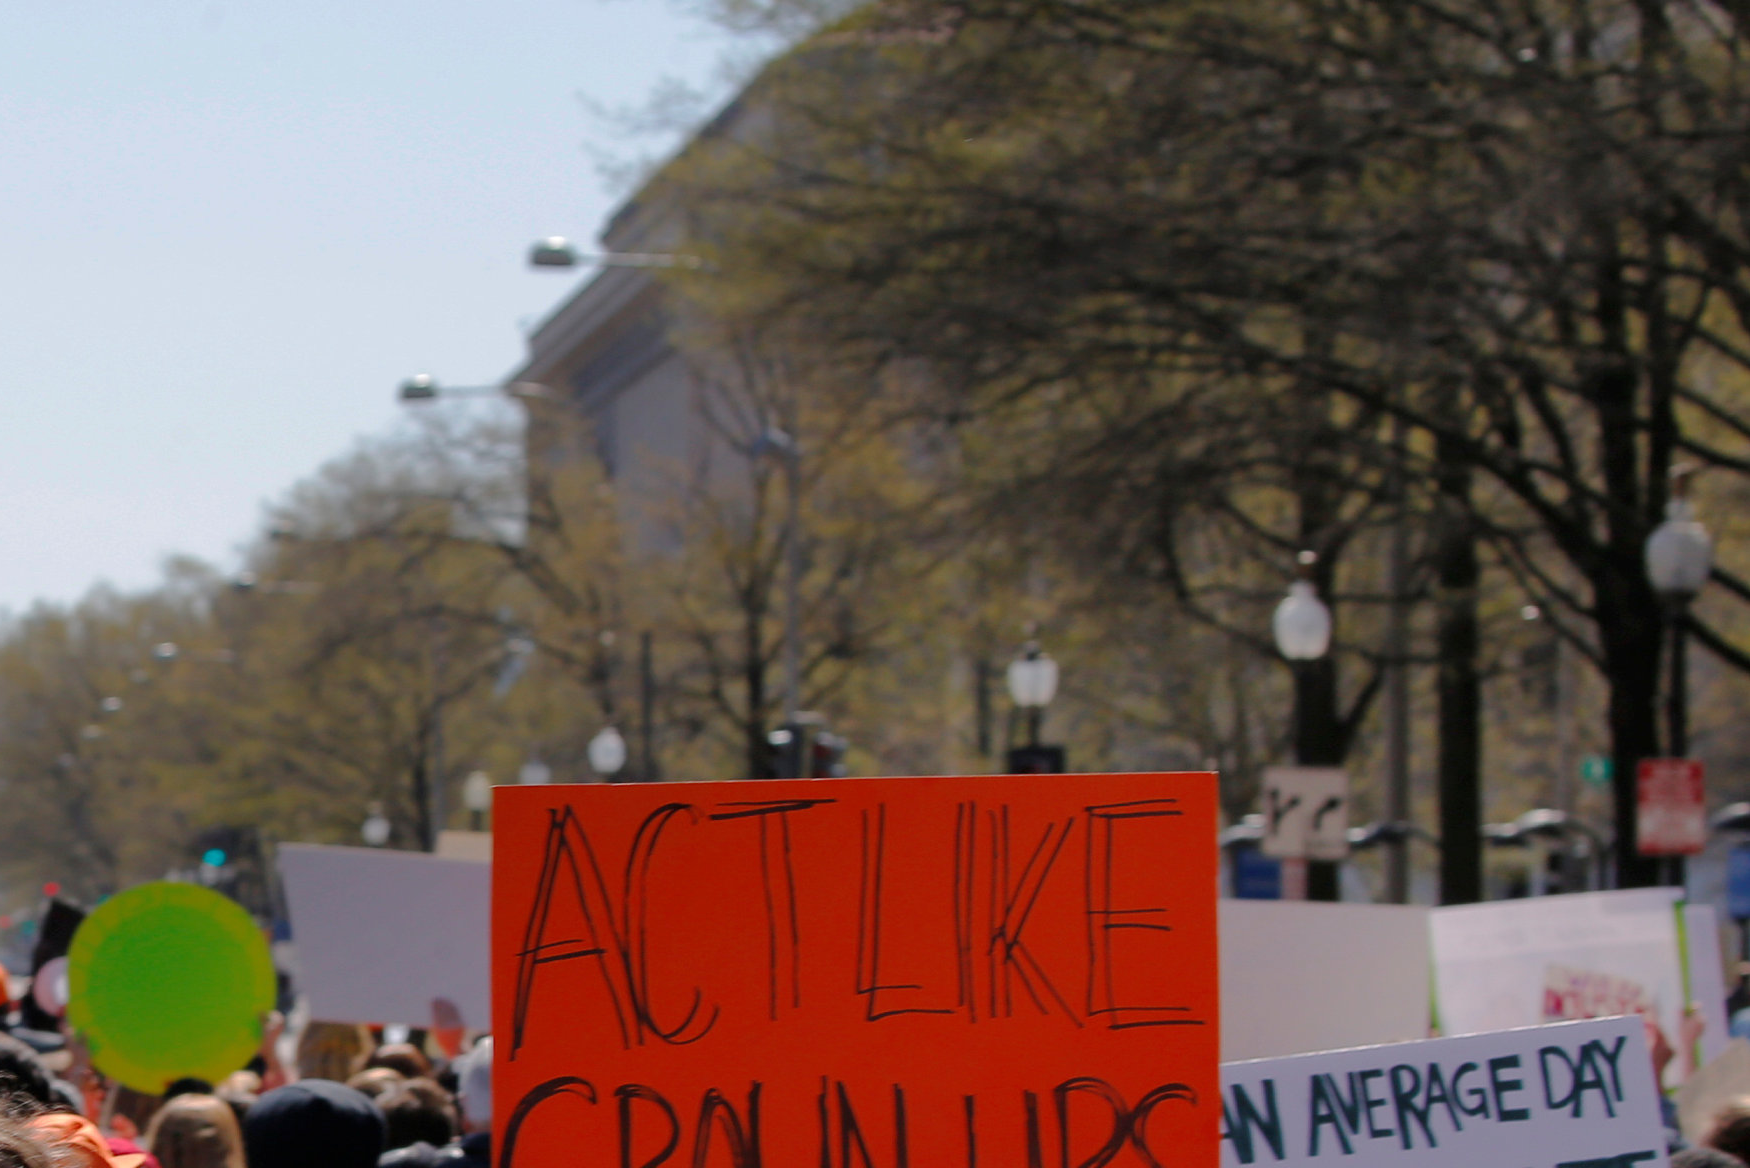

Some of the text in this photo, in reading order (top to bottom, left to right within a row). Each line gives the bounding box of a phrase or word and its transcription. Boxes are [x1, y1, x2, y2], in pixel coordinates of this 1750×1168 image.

[509, 798, 1206, 1062] ACT LIKE
[1308, 1054, 1530, 1157] AVERAGE
[1539, 1035, 1628, 1119] DAY
